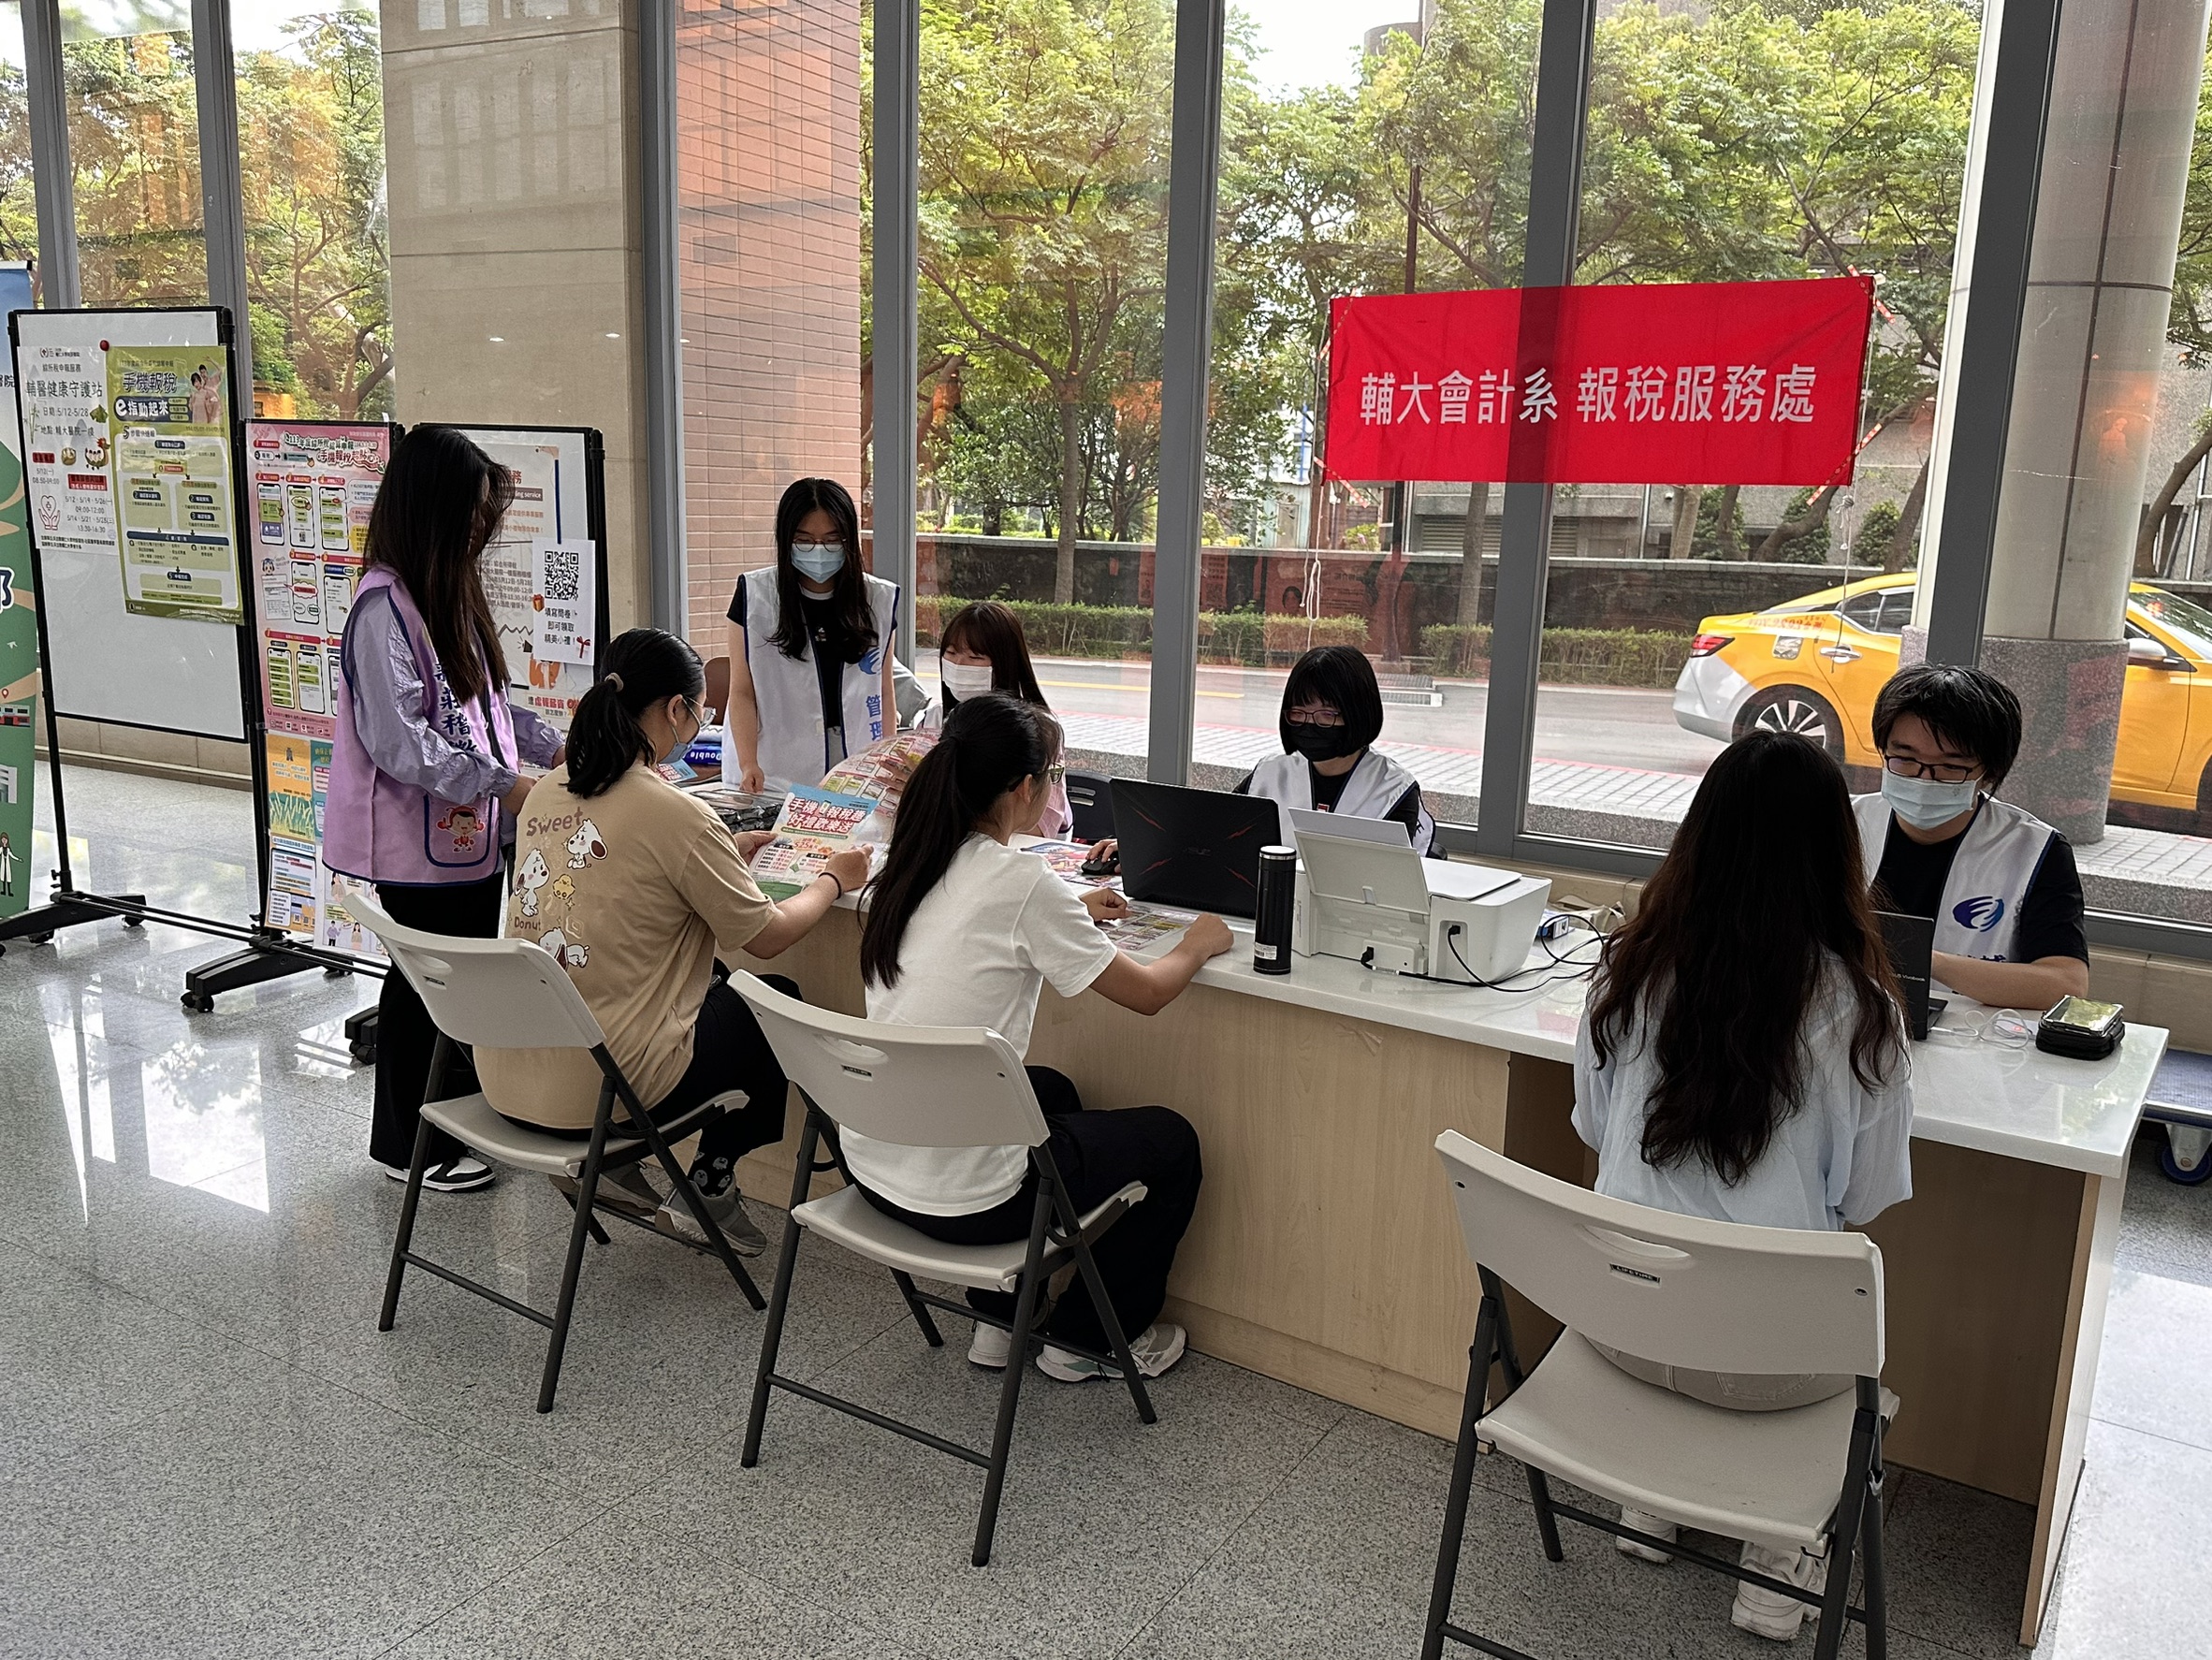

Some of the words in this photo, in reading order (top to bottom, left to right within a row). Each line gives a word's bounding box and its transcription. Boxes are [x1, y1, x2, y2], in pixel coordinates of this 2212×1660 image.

[26, 379, 103, 398] 輔醫健康守護站
[123, 372, 178, 394] 手機報稅
[1359, 367, 1558, 427] 輔大會計系
[1576, 363, 1815, 424] 報稅服務處
[547, 620, 575, 633] 即可領取
[526, 806, 584, 837] Sweet
